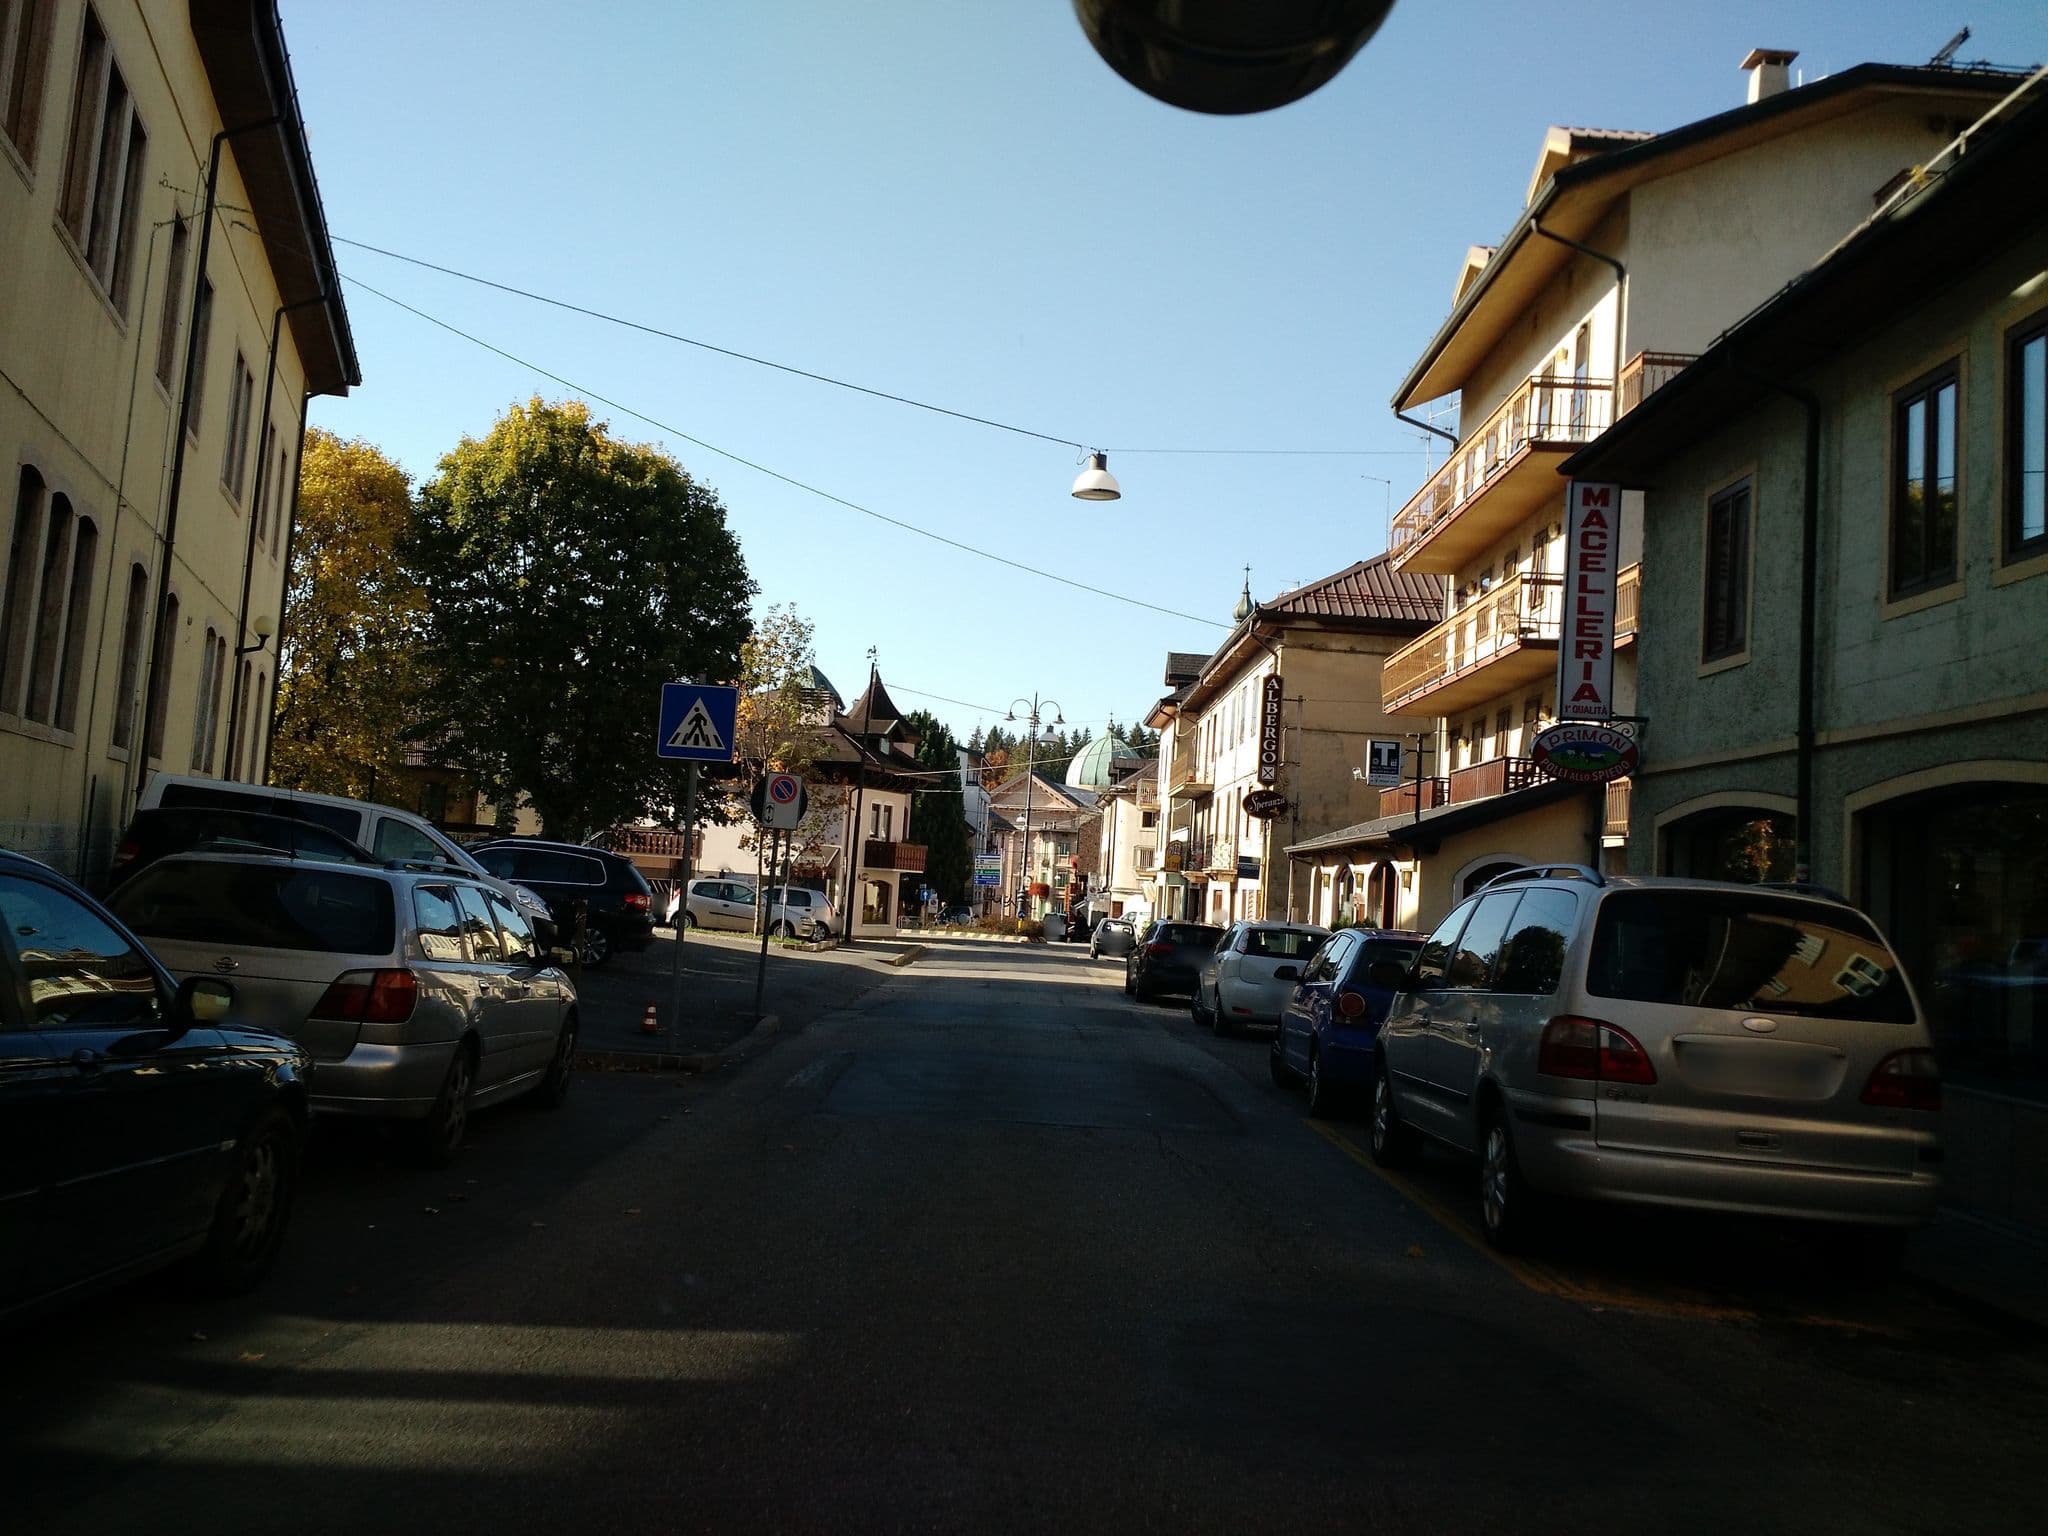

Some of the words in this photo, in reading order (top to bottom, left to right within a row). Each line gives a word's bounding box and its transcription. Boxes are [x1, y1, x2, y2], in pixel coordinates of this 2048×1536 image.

[1571, 487, 1610, 703] MACELLERIA
[1261, 678, 1280, 763] ALBERGO
[1572, 704, 1608, 715] QUALITÀ
[1549, 729, 1626, 750] PRIMON
[1540, 758, 1569, 778] POLLI
[1592, 760, 1630, 781] SPIEDO
